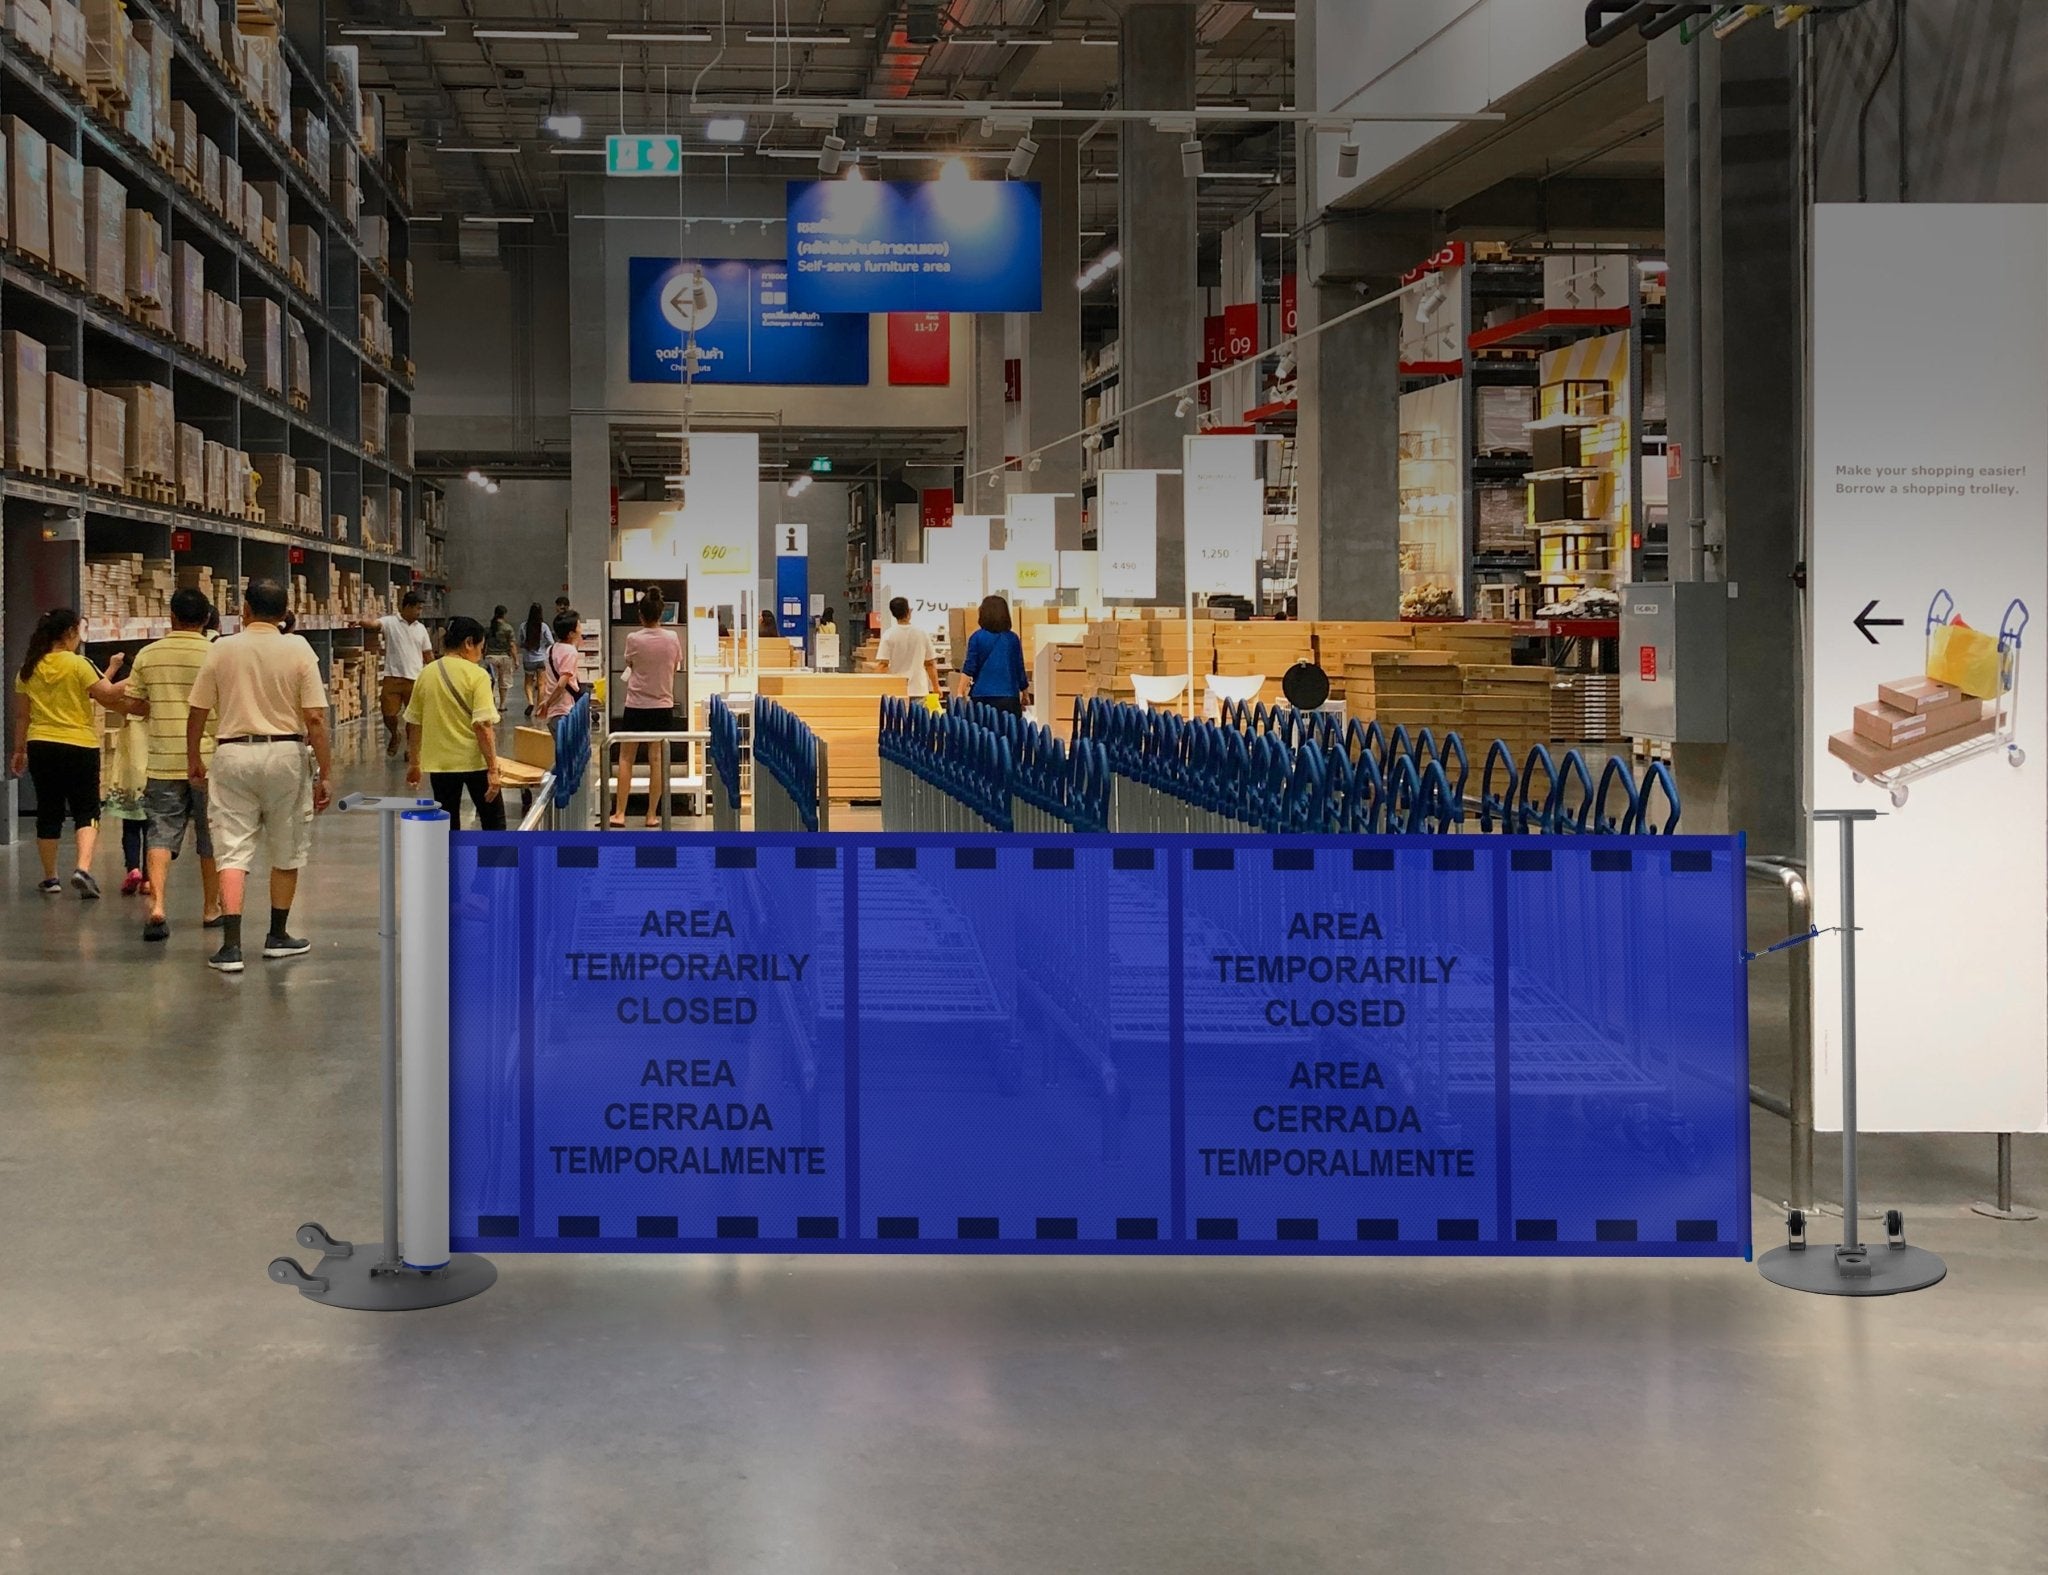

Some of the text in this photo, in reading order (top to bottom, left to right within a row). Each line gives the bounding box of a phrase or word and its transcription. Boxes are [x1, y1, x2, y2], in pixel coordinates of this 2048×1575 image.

[798, 260, 951, 272] Self-serve furniture area
[914, 323, 939, 332] 11-17
[1230, 336, 1251, 355] 09
[1835, 464, 2026, 478] Make your shopping easier!
[1835, 483, 2019, 497] Borrow a shopping trolley.
[702, 544, 727, 559] 690
[1201, 549, 1230, 560] 1,250
[640, 910, 736, 938] AREA
[1287, 912, 1384, 940] AREA
[565, 952, 810, 982] TEMPORARILY
[1213, 955, 1458, 984] TEMPORARILY
[616, 997, 758, 1025] CLOSED
[1264, 999, 1406, 1027] CLOSED
[640, 1059, 736, 1087] AREA
[1288, 1061, 1385, 1089] AREA
[604, 1102, 774, 1131] CERRADA
[1252, 1104, 1423, 1133] CERRADA
[550, 1146, 826, 1175] TEMPORALMENTE
[1199, 1148, 1476, 1177] TEMPORALMENTE
